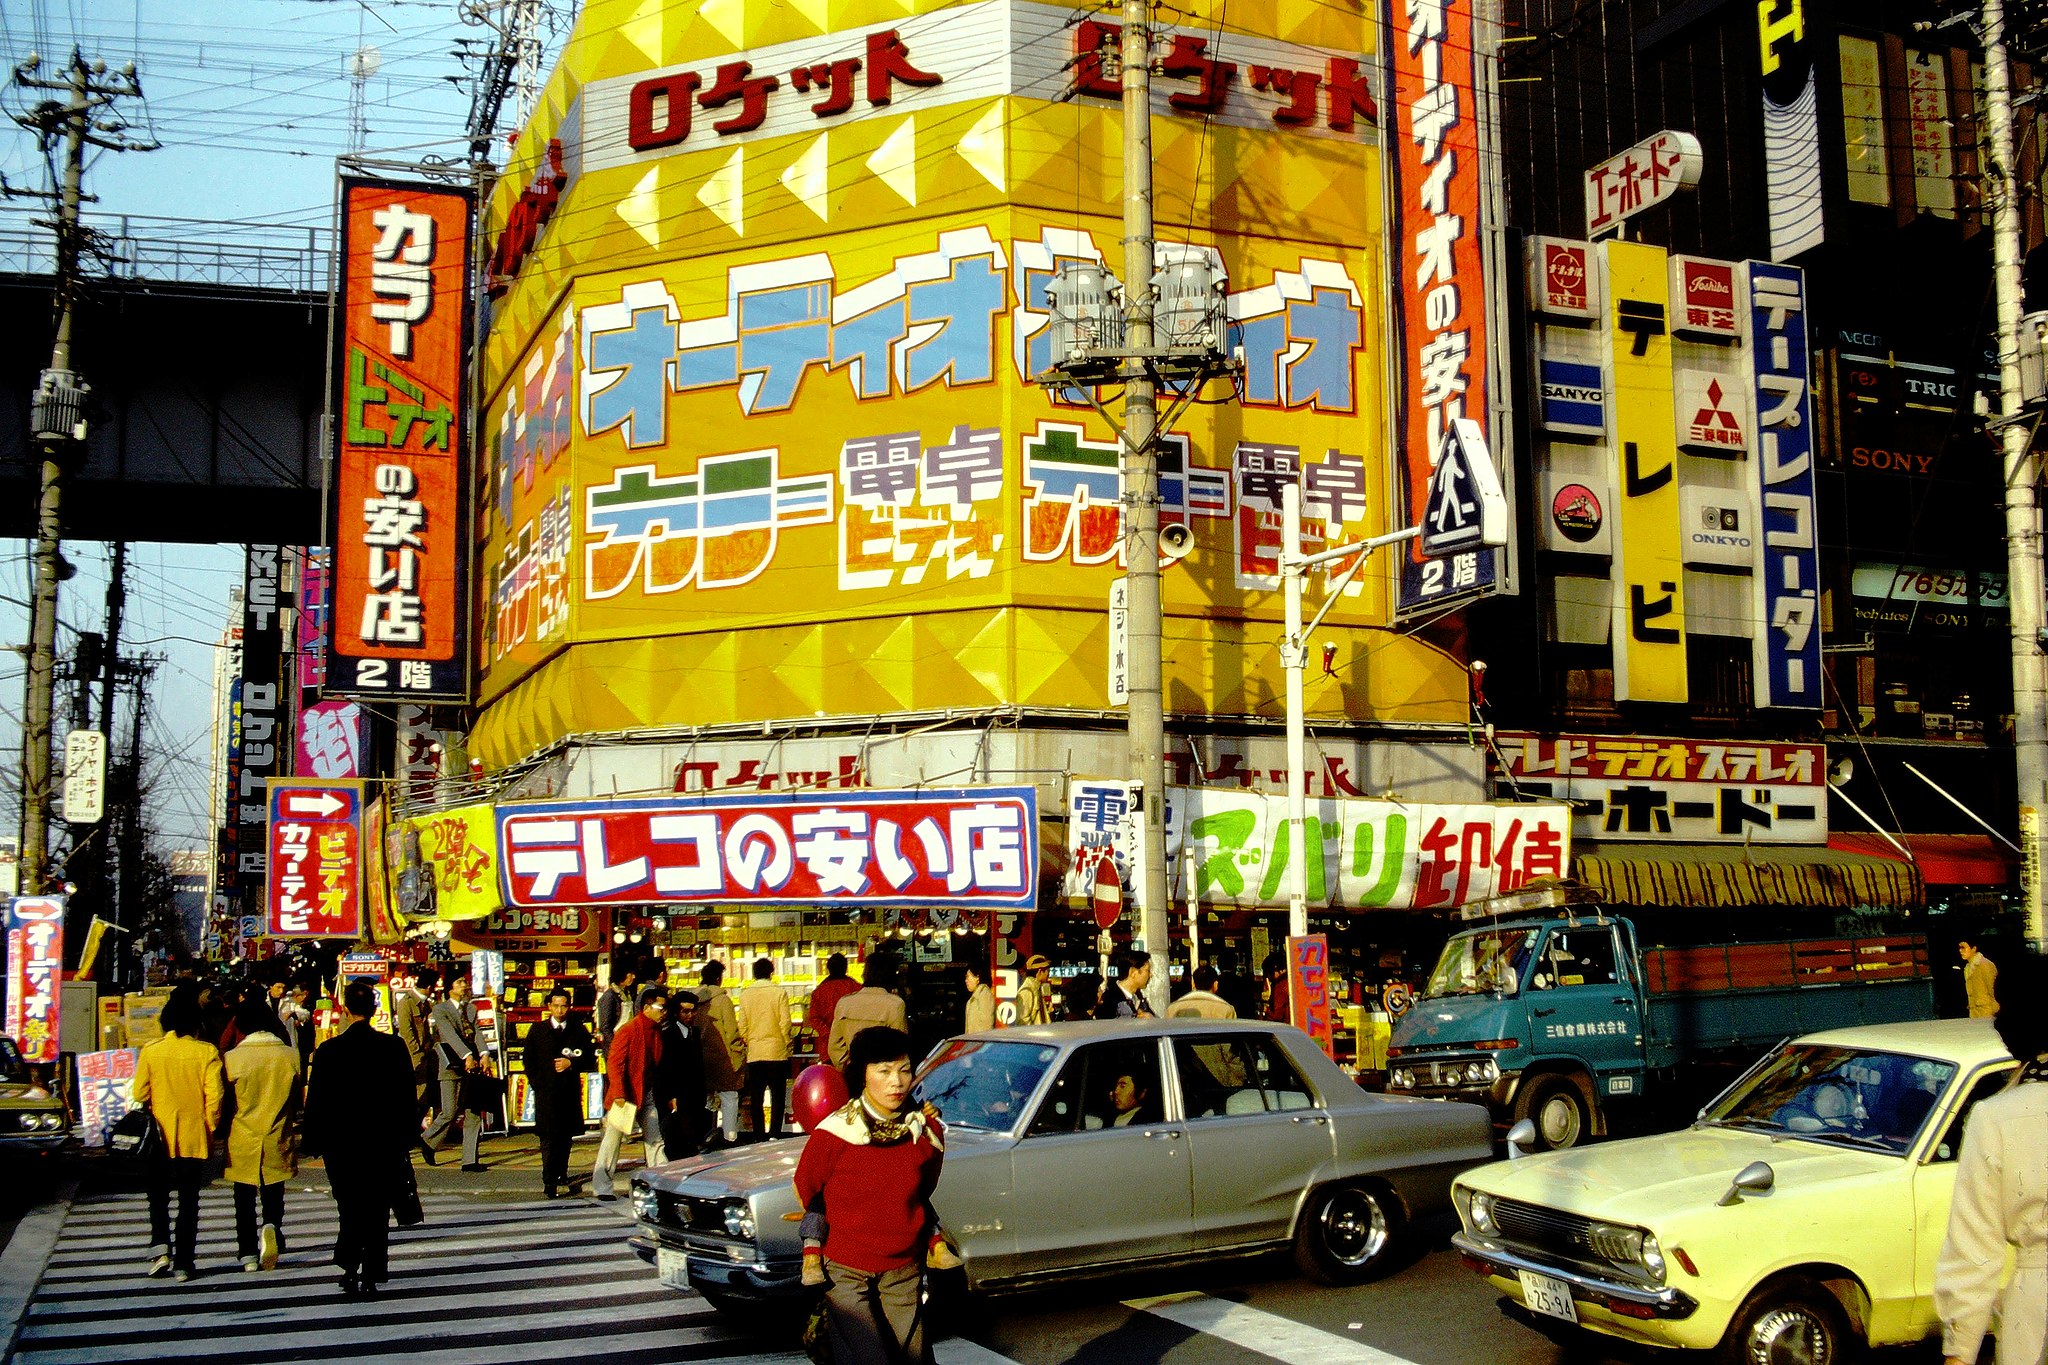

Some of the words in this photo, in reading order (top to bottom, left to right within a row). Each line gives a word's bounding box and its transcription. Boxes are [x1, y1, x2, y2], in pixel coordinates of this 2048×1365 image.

[628, 29, 944, 151] ロケット
[1072, 20, 1387, 132] ロケット
[371, 204, 434, 357] カラー
[1406, 0, 1467, 492] オーディオの安い
[1688, 275, 1730, 294] Toshiba
[579, 225, 1007, 452] オーディオ
[1687, 308, 1735, 330] 東芝
[347, 345, 455, 450] ビデオ
[1541, 384, 1603, 401] SANYO
[1690, 426, 1743, 446] 三菱電機
[839, 428, 1003, 508] 電卓
[1233, 440, 1367, 540] 電卓
[1617, 297, 1681, 645] テレビ
[1752, 275, 1817, 694] テープレコーダー
[1852, 447, 1934, 473] SONY
[358, 463, 424, 642] の安い店
[1420, 552, 1478, 597] 2階
[1692, 532, 1751, 548] ONKYO
[248, 544, 278, 631] KET
[356, 659, 433, 690] 2階
[279, 823, 314, 931] カラーテレビ
[318, 831, 353, 917] ビデオ
[509, 805, 1023, 896] テレコの安い店
[24, 922, 57, 1060] オーディオ祭り
[342, 963, 387, 973] ビデオテレビ
